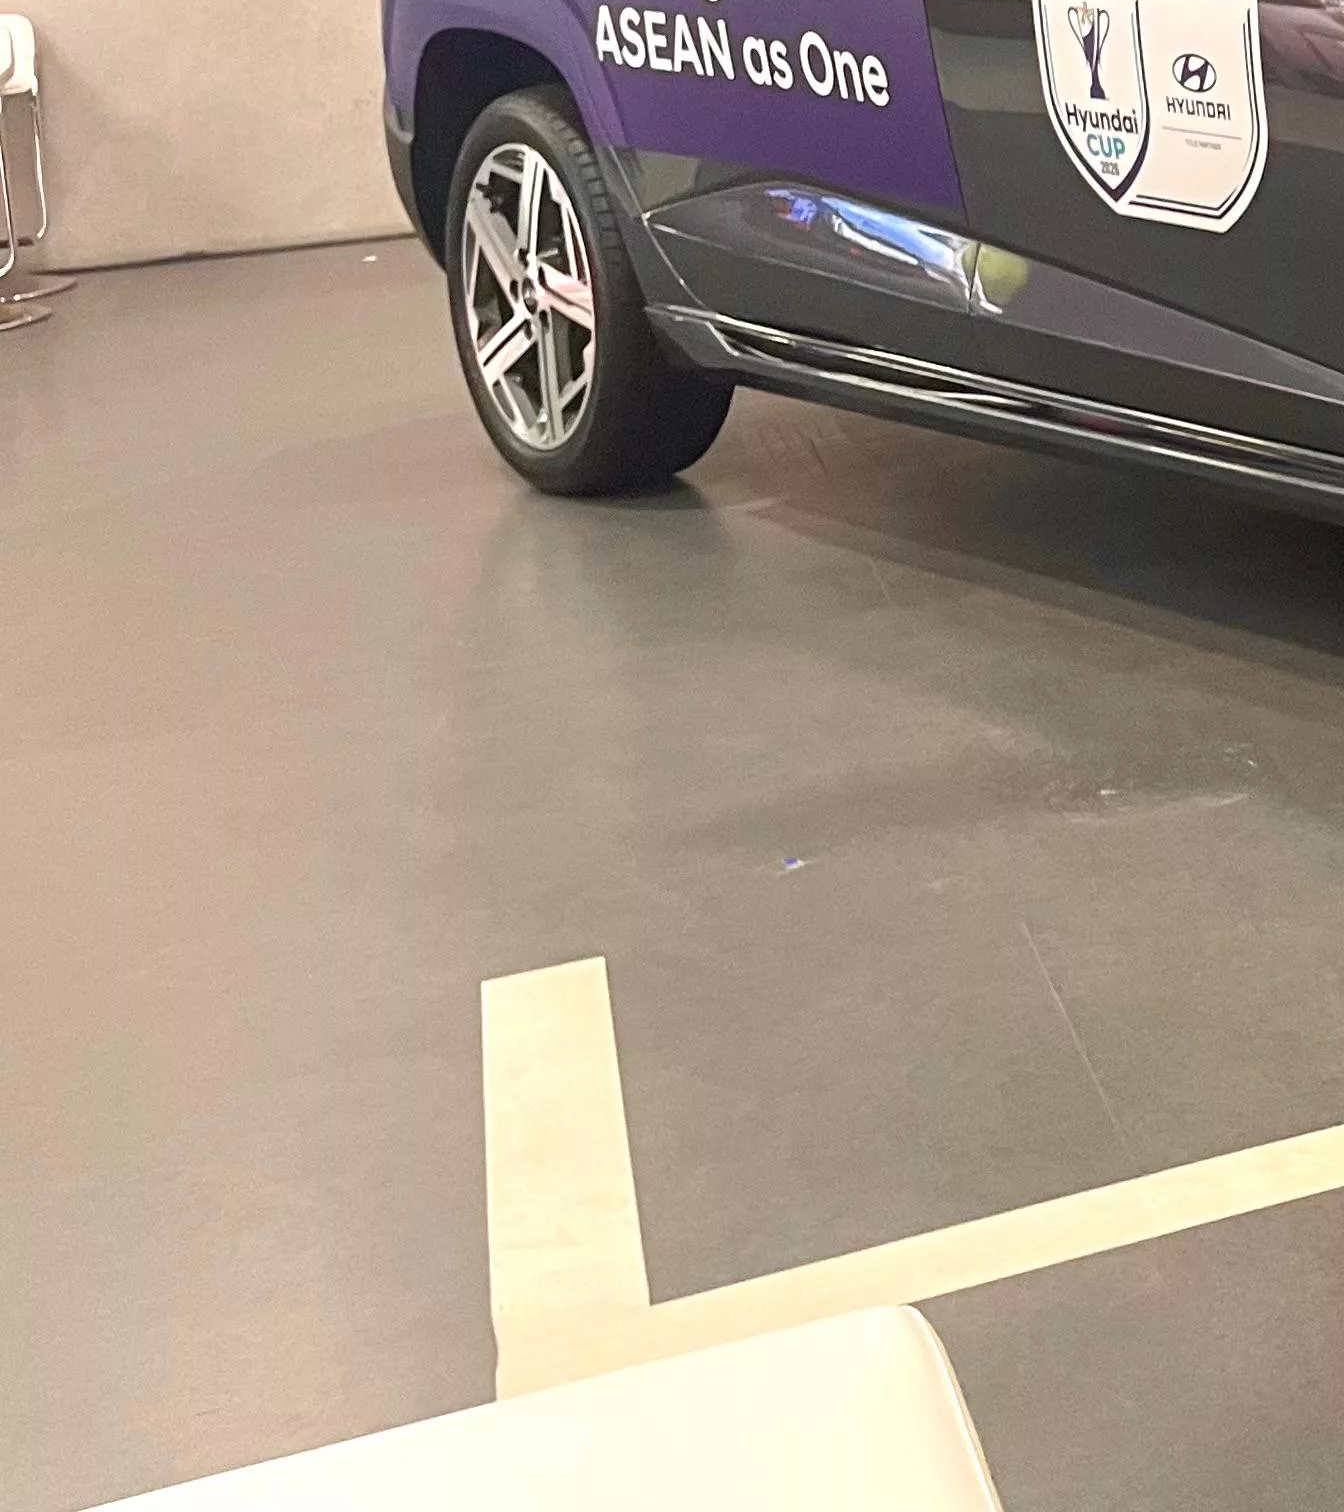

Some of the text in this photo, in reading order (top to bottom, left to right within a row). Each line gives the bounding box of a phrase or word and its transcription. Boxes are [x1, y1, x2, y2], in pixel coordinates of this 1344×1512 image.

[596, 4, 890, 107] ASEAN as One
[1065, 101, 1139, 135] Hyundai
[1165, 95, 1231, 121] HYUNDAI
[1086, 133, 1126, 160] CUP
